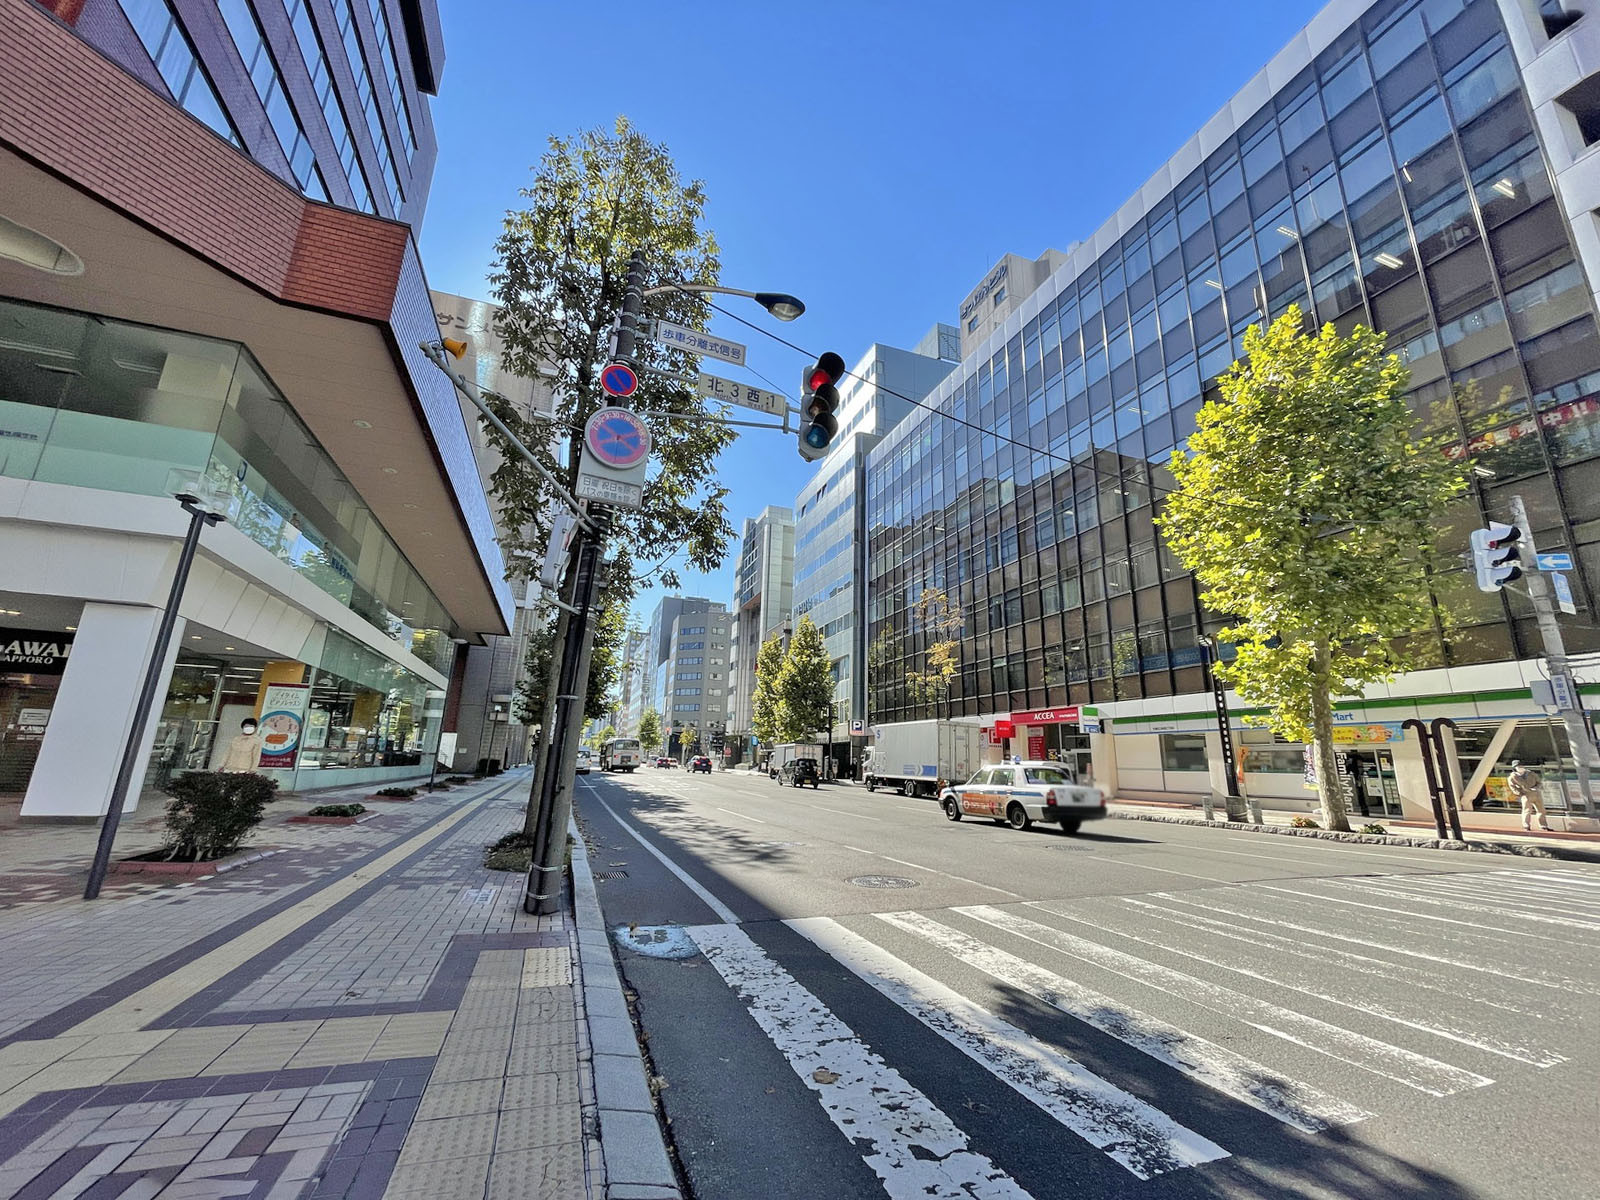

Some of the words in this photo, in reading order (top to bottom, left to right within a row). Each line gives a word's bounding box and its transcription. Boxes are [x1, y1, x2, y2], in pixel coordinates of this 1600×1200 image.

[664, 329, 741, 359] 歩車分離式信号
[1034, 711, 1055, 720] ACCEA
[853, 721, 861, 730] P
[1336, 752, 1354, 814] FamilyMart
